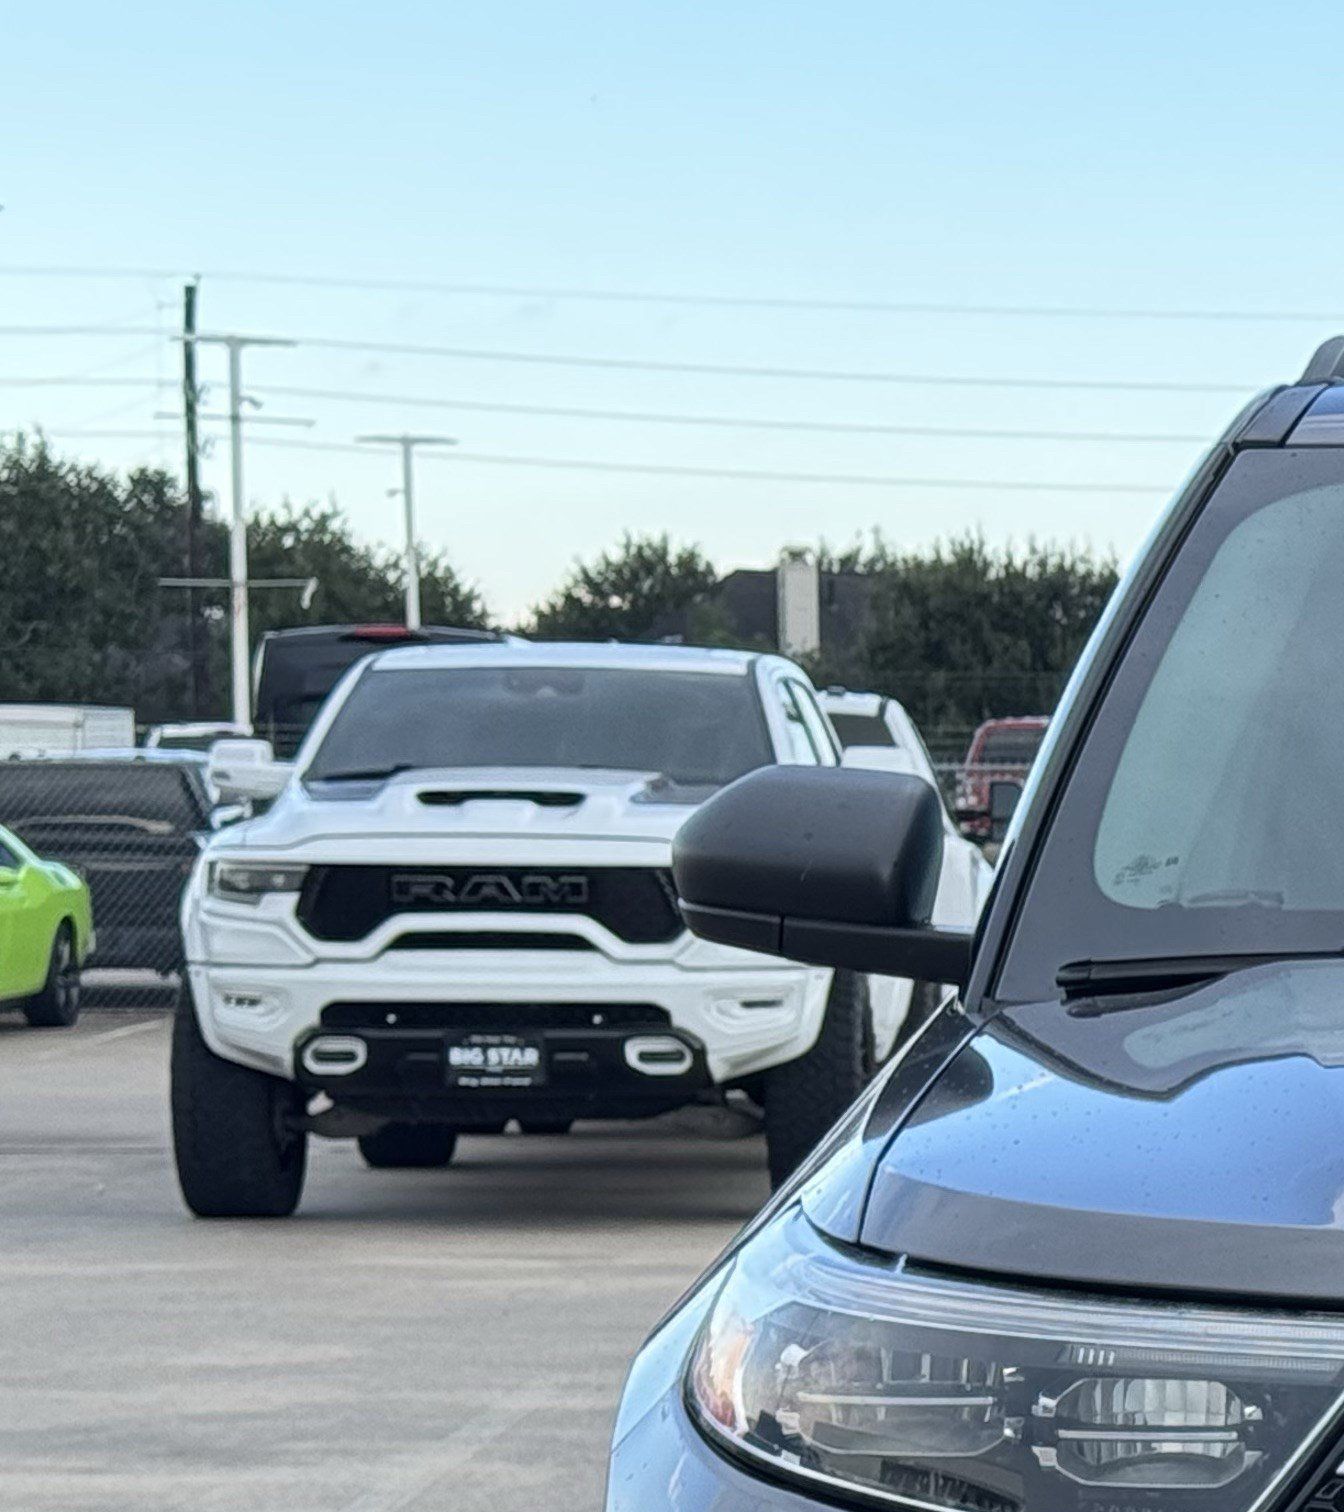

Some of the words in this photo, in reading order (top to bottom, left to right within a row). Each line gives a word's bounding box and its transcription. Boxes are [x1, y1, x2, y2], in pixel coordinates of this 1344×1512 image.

[391, 874, 588, 903] RAM
[449, 1046, 484, 1066] BIG
[486, 1046, 540, 1067] STAR
